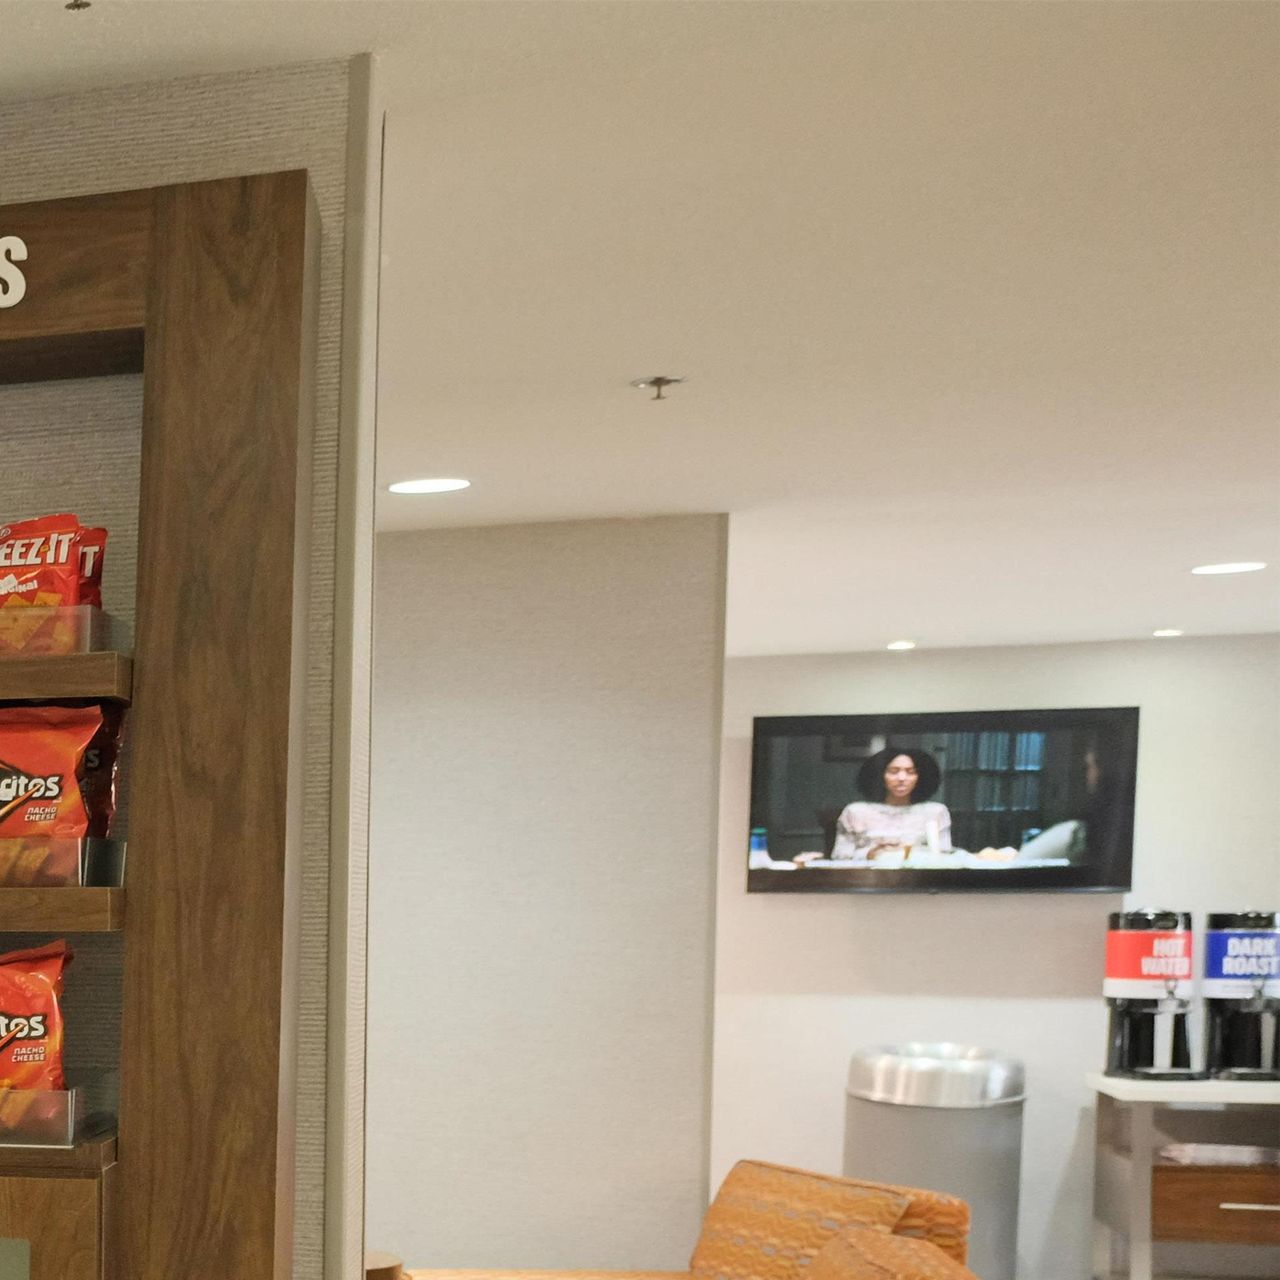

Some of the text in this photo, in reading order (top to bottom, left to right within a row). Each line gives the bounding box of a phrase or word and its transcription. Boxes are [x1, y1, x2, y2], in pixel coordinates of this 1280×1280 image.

[27, 806, 57, 814] NACHO
[24, 814, 57, 822] CHEESE
[1152, 938, 1186, 956] HOT
[1227, 937, 1277, 956] DARK
[1141, 956, 1190, 975] WATER
[1222, 956, 1280, 975] ROAST
[14, 1046, 45, 1054] NACHO
[11, 1054, 45, 1063] CHEESE
